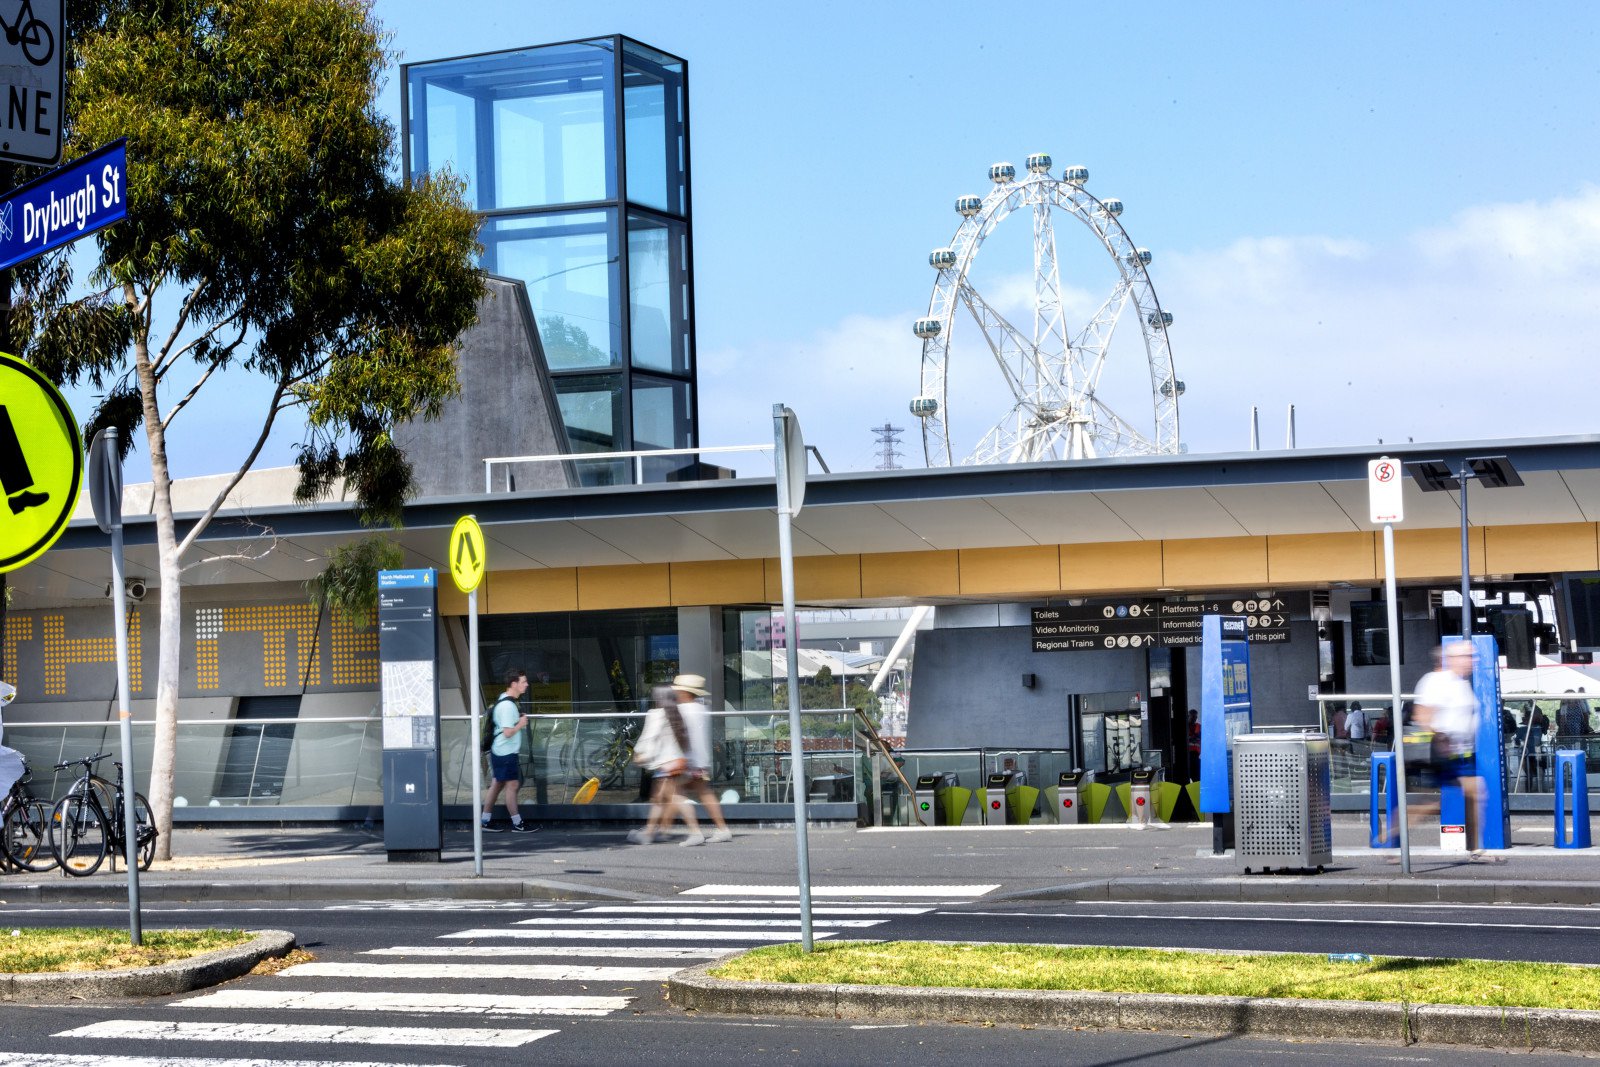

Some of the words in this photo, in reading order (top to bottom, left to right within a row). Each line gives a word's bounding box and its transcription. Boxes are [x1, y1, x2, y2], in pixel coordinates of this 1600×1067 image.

[0, 85, 52, 136] NE
[23, 174, 96, 245] Dryburgh
[102, 164, 120, 208] St
[1162, 604, 1198, 613] Platforms
[1034, 611, 1059, 619] Toilets
[1035, 626, 1057, 634] Video
[1059, 625, 1099, 633] Monitoring
[1163, 635, 1193, 644] Validated
[1268, 632, 1286, 642] point
[1036, 641, 1069, 650] Regional
[1071, 639, 1094, 647] Trains
